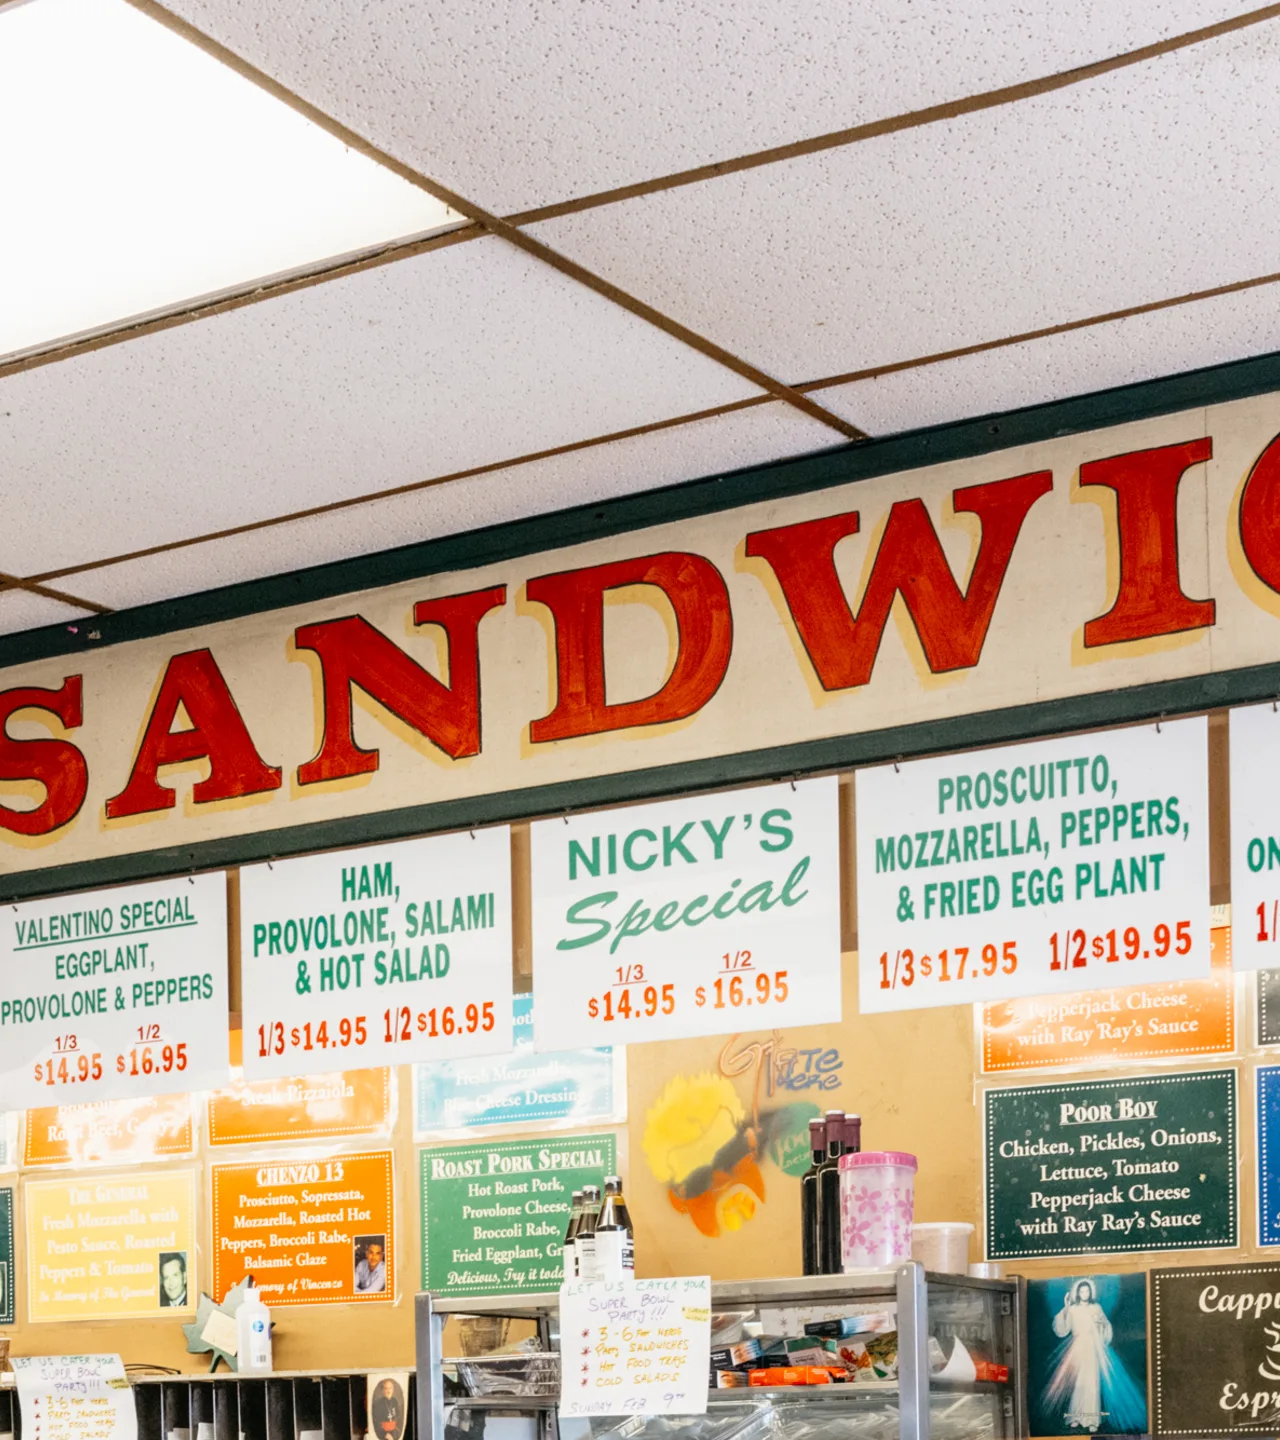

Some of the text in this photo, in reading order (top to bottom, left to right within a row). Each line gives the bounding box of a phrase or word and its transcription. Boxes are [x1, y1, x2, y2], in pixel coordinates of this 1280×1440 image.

[939, 755, 1117, 814] PROSCUITTO,
[569, 809, 793, 880] NICKY'S
[876, 796, 1189, 873] MOZZARELLA, PEPPERS,
[342, 862, 400, 902] HAM,
[556, 842, 810, 955] Special
[897, 853, 1165, 922] & FRIED EGG PLANT
[15, 896, 196, 943] VALENTINO SPECIAL
[254, 893, 494, 957] PROVOLONE, SALAMI
[56, 943, 154, 980] EGGPLANT,
[295, 944, 450, 996] & HOT SALAD
[614, 964, 646, 984] 1/3
[722, 950, 753, 971] 1/2
[1, 973, 213, 1025] PROVOLONE & PEPPERS
[589, 984, 674, 1021] $14.95
[696, 968, 788, 1008] $16.95
[999, 1127, 1222, 1158] Chicken, Pickles, Onions,
[256, 1162, 344, 1187] CHENZO 13
[239, 1188, 365, 1209] Prosciutto, Sopressata,
